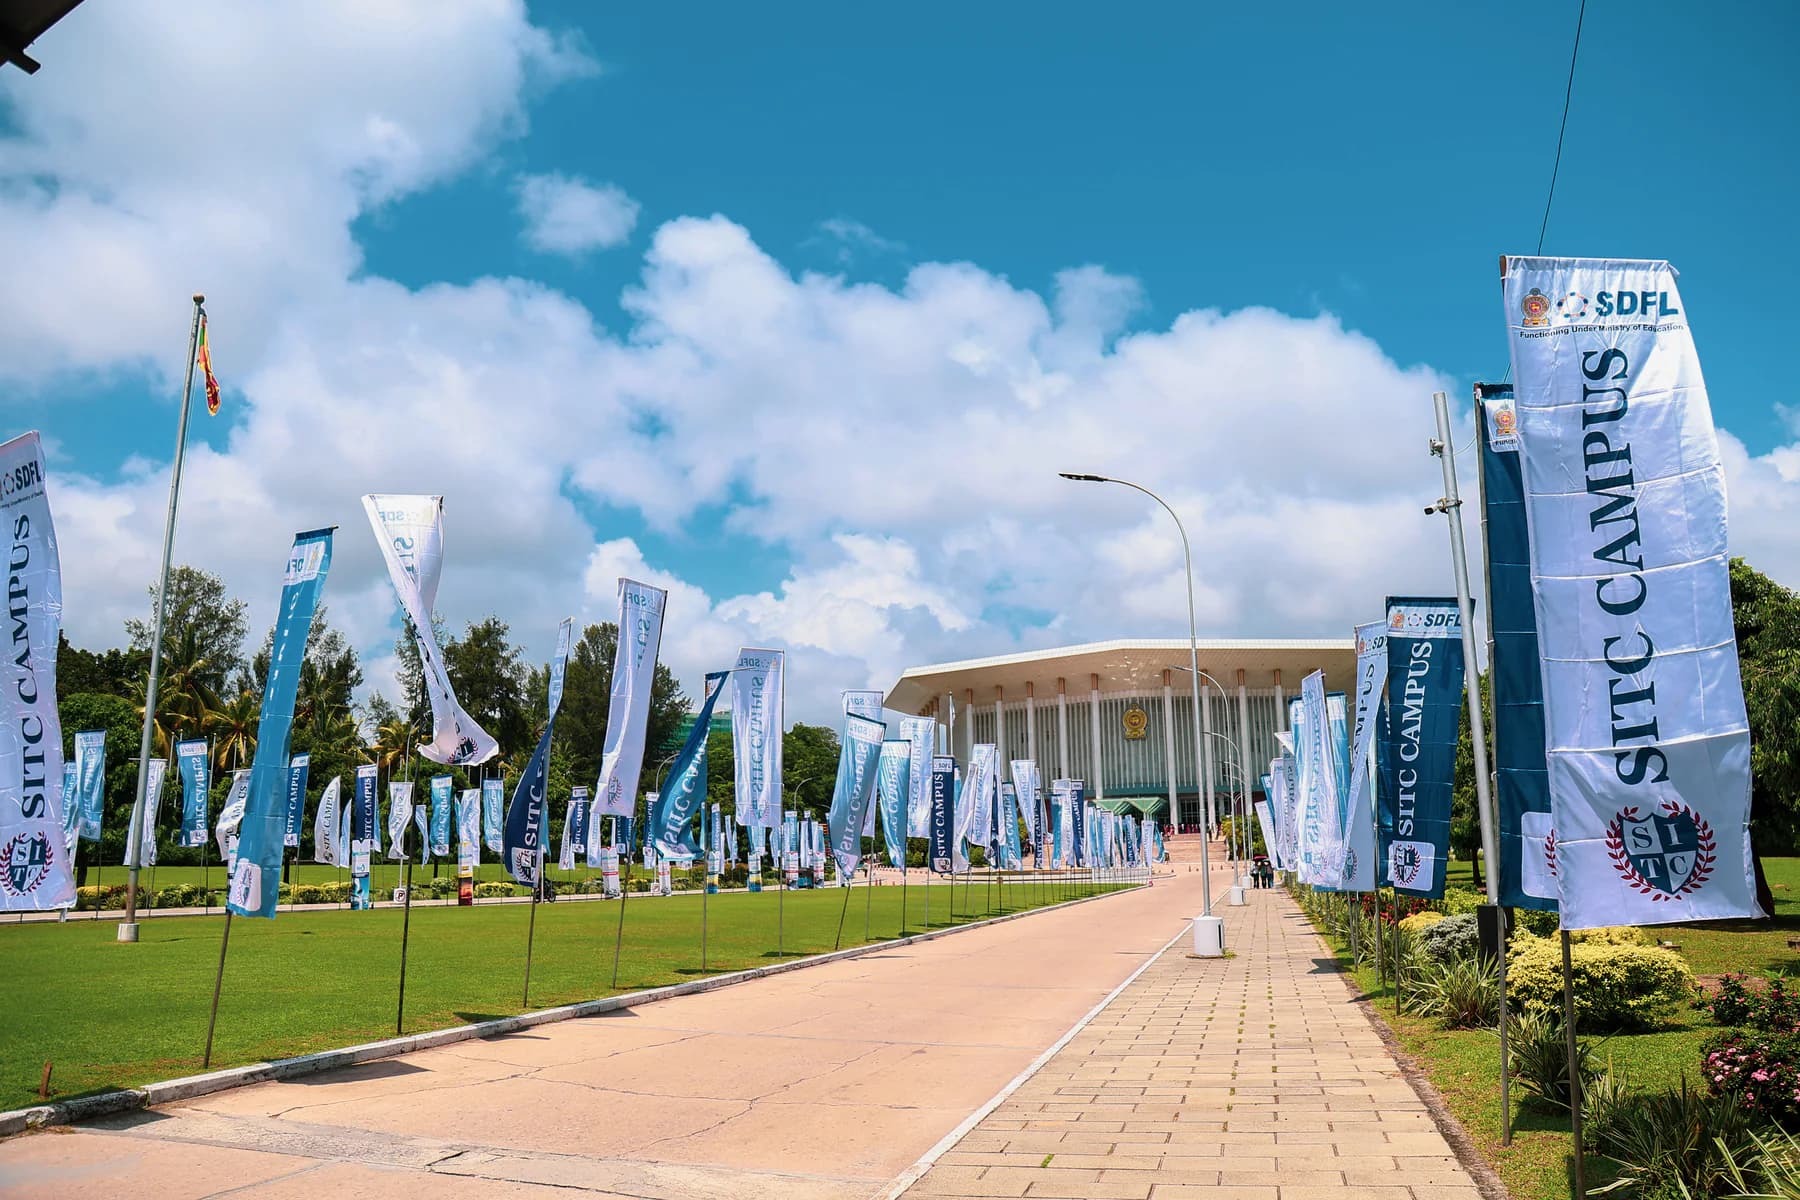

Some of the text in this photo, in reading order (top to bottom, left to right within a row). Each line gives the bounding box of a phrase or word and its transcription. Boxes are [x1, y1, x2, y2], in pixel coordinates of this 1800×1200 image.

[1519, 322, 1685, 339] Functioning Under Ministry of Education
[1595, 290, 1679, 317] SDFL
[15, 460, 42, 491] SDFL
[1582, 347, 1670, 786] SITC CAMPUS
[8, 513, 38, 705] CAMPUS
[1424, 613, 1462, 627] SDFL
[21, 716, 46, 819] SITC
[1398, 641, 1433, 837] SITC CAMPUS
[289, 767, 300, 810] CAMPUS
[323, 788, 337, 850] SITC CAMPUS
[364, 777, 373, 839] SITC CAMPUS
[524, 785, 543, 847] SITC
[934, 773, 946, 857] SITC CAMPUS
